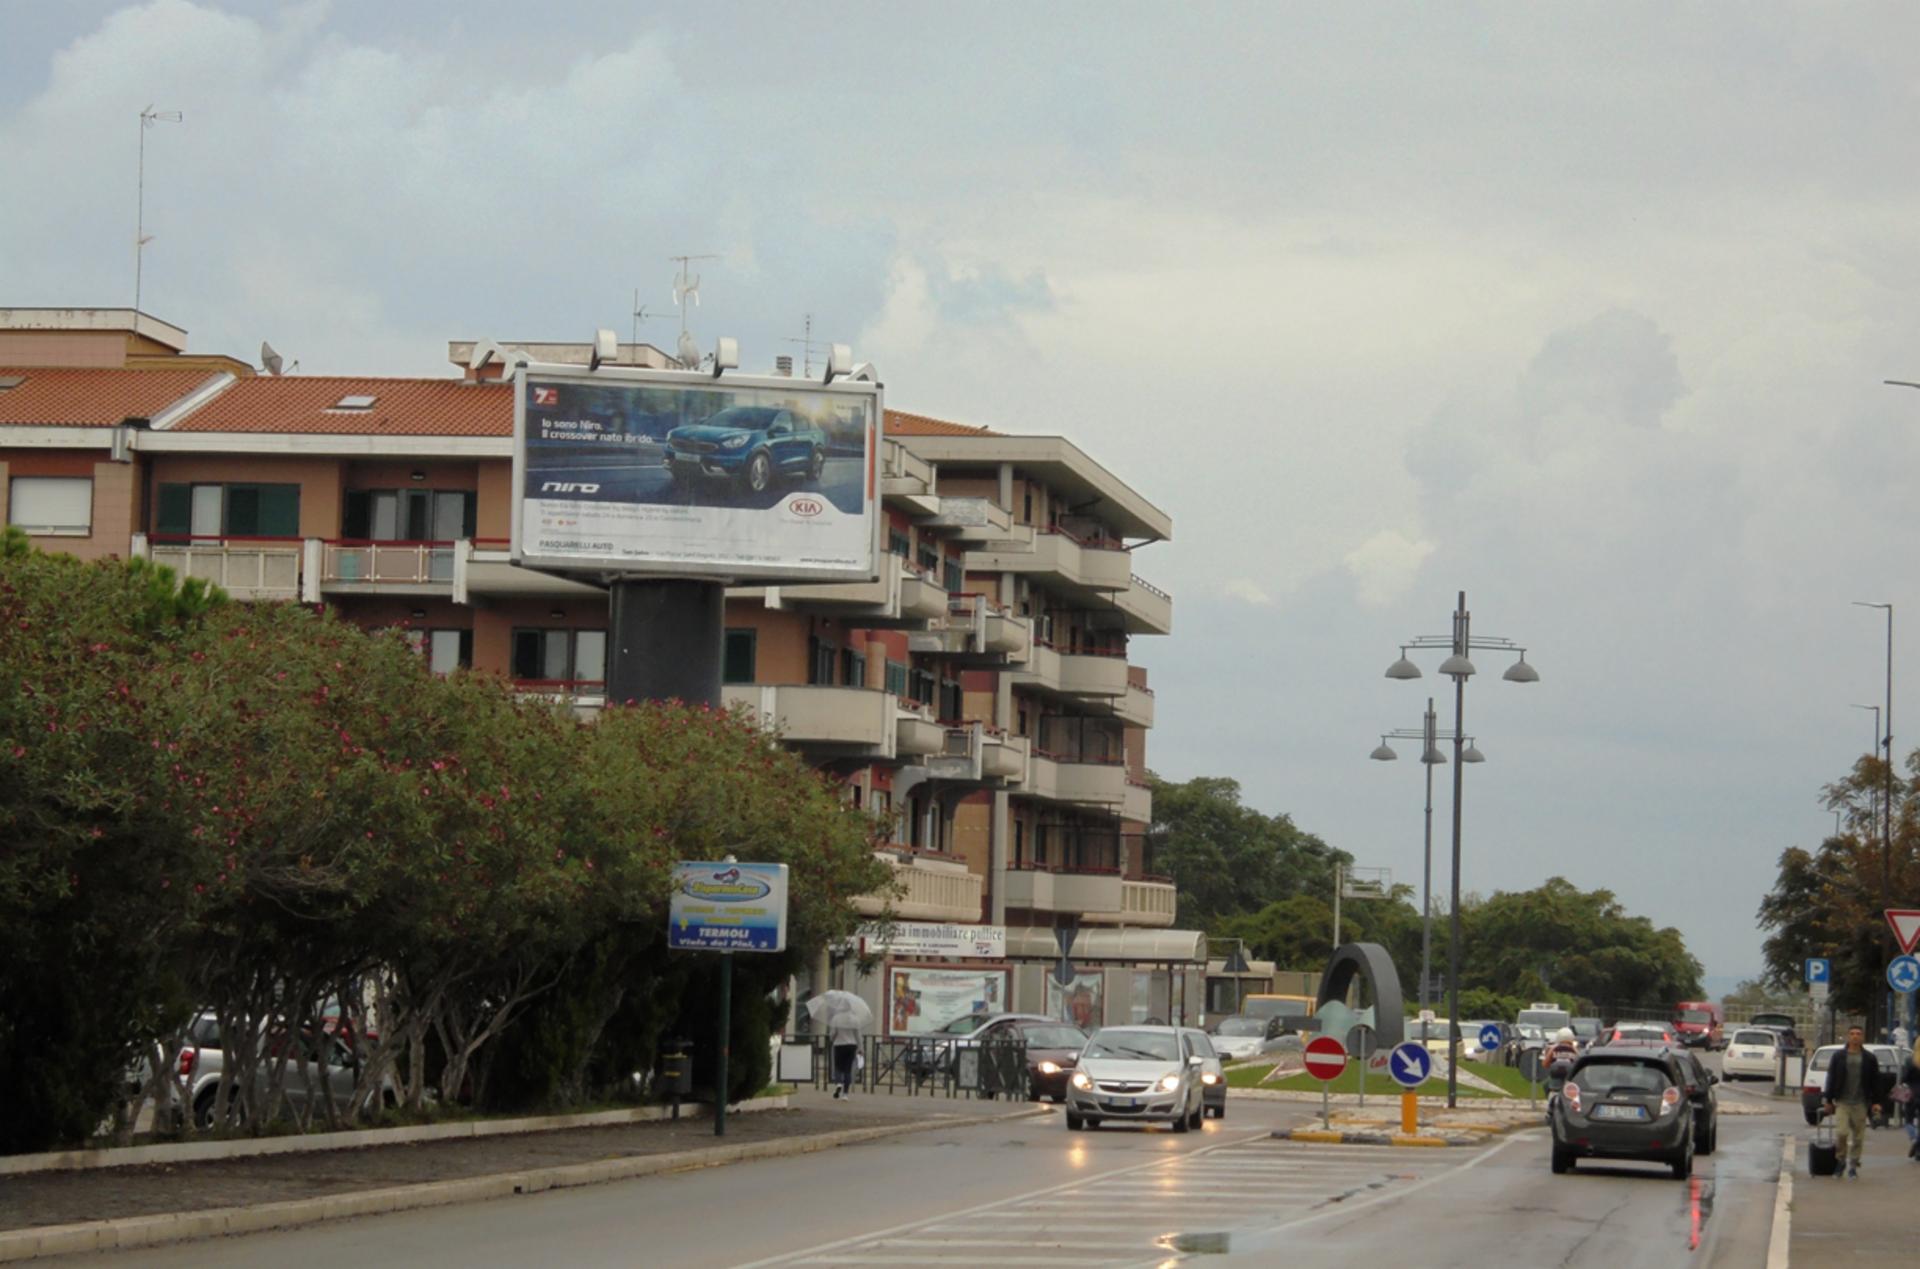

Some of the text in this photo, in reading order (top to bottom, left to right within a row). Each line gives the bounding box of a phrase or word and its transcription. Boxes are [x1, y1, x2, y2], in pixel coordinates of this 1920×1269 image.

[554, 420, 577, 430] sono
[550, 431, 598, 441] crossover
[600, 433, 622, 442] nato
[541, 481, 600, 494] niro
[794, 501, 818, 514] KIA
[592, 542, 614, 551] AUTO
[699, 927, 750, 939] TERMOLI
[908, 924, 968, 941] immobiliare
[1810, 961, 1825, 980] P
